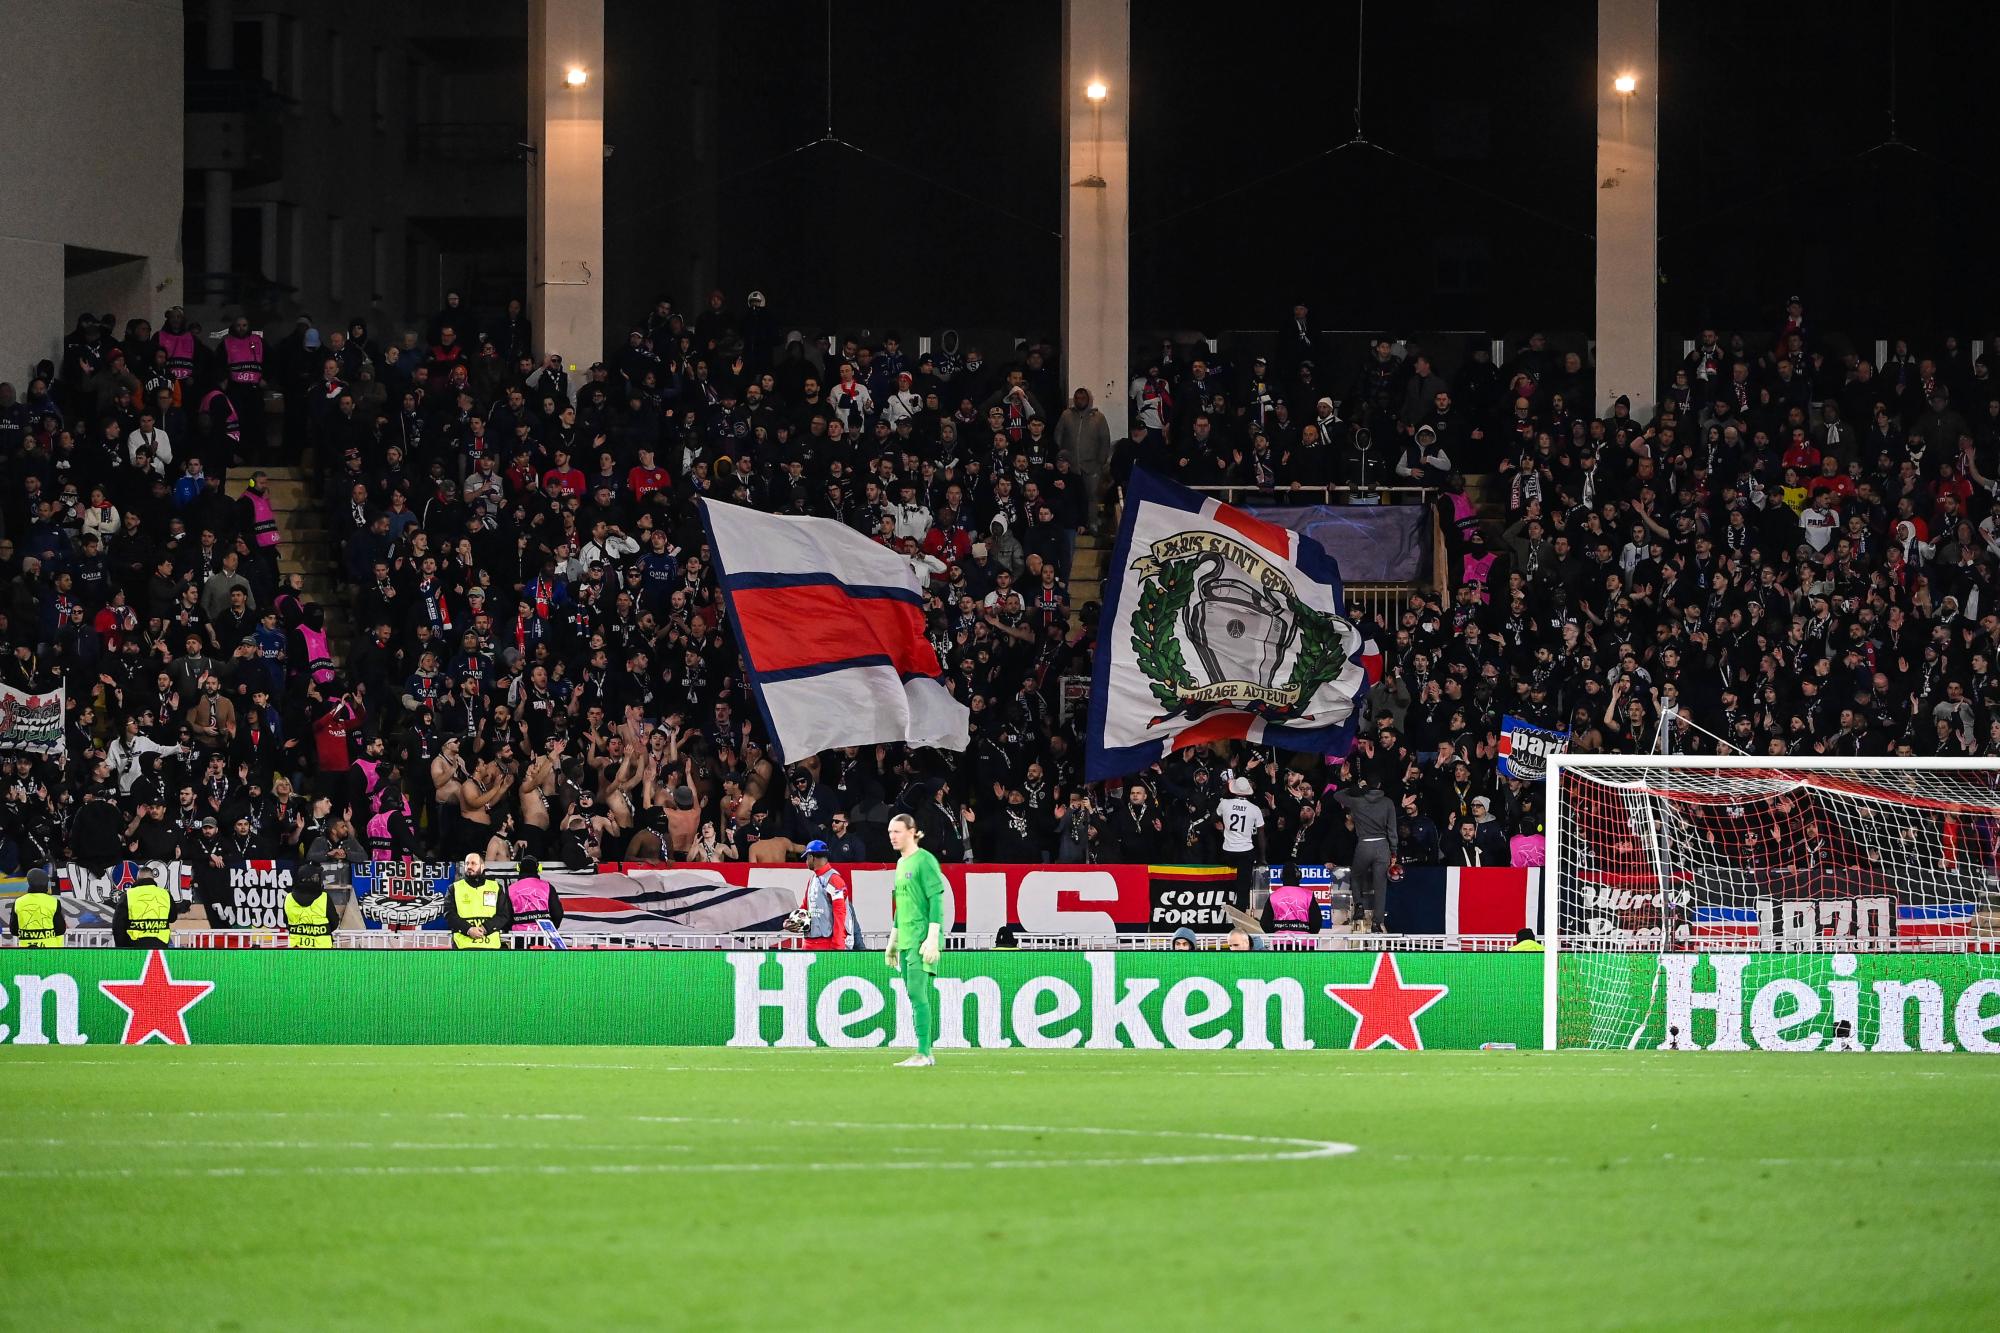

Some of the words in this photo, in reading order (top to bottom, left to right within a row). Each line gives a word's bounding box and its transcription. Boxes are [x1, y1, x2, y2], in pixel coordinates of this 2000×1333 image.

[1209, 538, 1259, 573] SAINT
[1230, 814, 1246, 832] 21
[355, 861, 371, 877] LE
[374, 861, 406, 877] PSG
[230, 868, 293, 888] KAMA
[371, 880, 389, 896] LE
[392, 879, 434, 896] PARC
[1160, 890, 1238, 906] COULY
[130, 921, 167, 930] STEWARD
[290, 925, 328, 935] TEWARD
[1757, 896, 1890, 950] 1970
[18, 930, 56, 939] STEWARD
[300, 937, 316, 947] 101
[0, 973, 88, 1044] n
[725, 953, 1315, 1049] Heineken
[1657, 953, 2000, 1052] Heine
